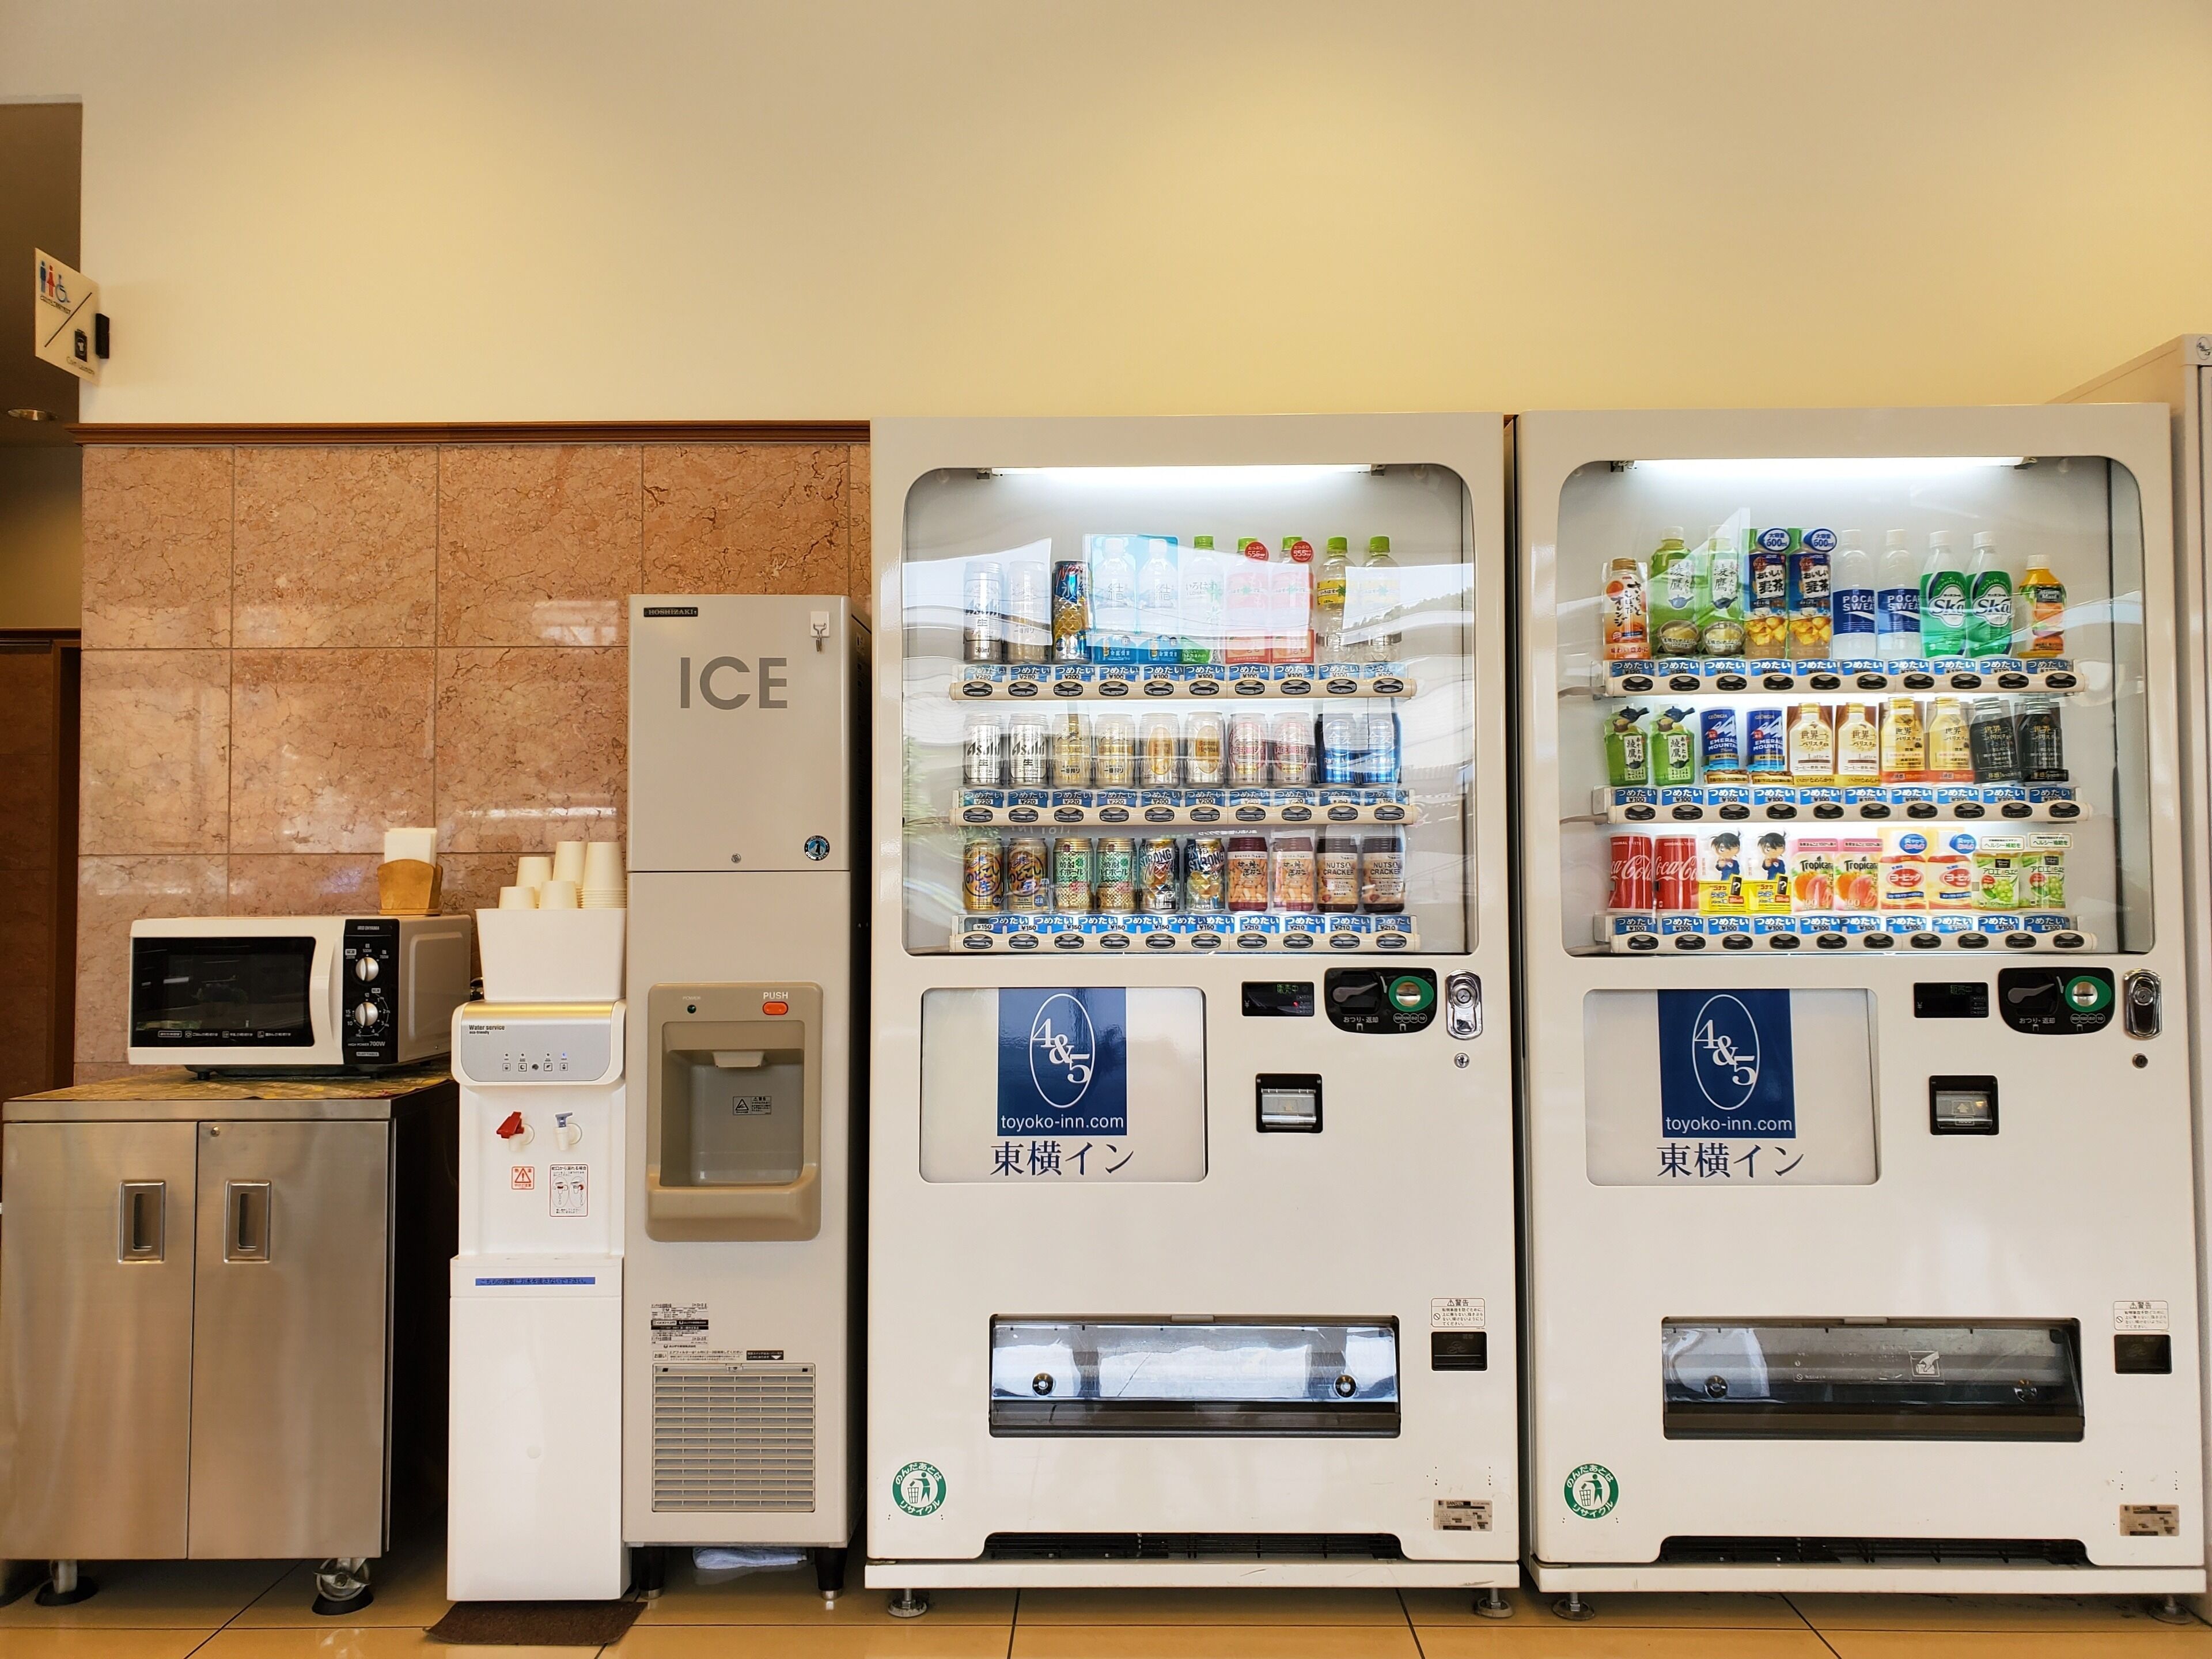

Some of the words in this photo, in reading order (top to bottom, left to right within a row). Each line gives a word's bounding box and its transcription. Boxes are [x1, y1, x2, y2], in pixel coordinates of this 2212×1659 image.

[1767, 539, 1788, 547] 600ml
[1757, 570, 1783, 579] おいしい
[1804, 570, 1830, 579] おいしい
[1759, 579, 1783, 594] 麦茶
[1805, 579, 1830, 594] 麦茶
[1611, 596, 1628, 627] オレンジ
[1185, 665, 1224, 673] つめたい
[1613, 661, 1653, 669] つめたい
[1797, 661, 1836, 669] つめたい
[680, 656, 787, 710] ICE
[1328, 732, 1351, 744] 金麦
[1369, 732, 1392, 744] 金麦
[967, 741, 1000, 756] Asahi
[1012, 741, 1045, 756] Asahi
[1230, 746, 1247, 755] LAGER
[1274, 746, 1291, 755] LAGER
[1140, 848, 1172, 868] STRONG
[1032, 1018, 1090, 1084] 4&5
[1694, 1020, 1756, 1085] 4&5
[1001, 1115, 1124, 1132] toyoko-inn.com
[1666, 1116, 1793, 1134] toyoko-inn.com
[990, 1141, 1134, 1176] 東横イン
[1657, 1142, 1804, 1178] 東横イン
[895, 1463, 942, 1484] のんだあとは
[1567, 1465, 1613, 1488] のんだあとは
[900, 1499, 940, 1515] リサイクル
[1572, 1501, 1613, 1517] リサイクル
